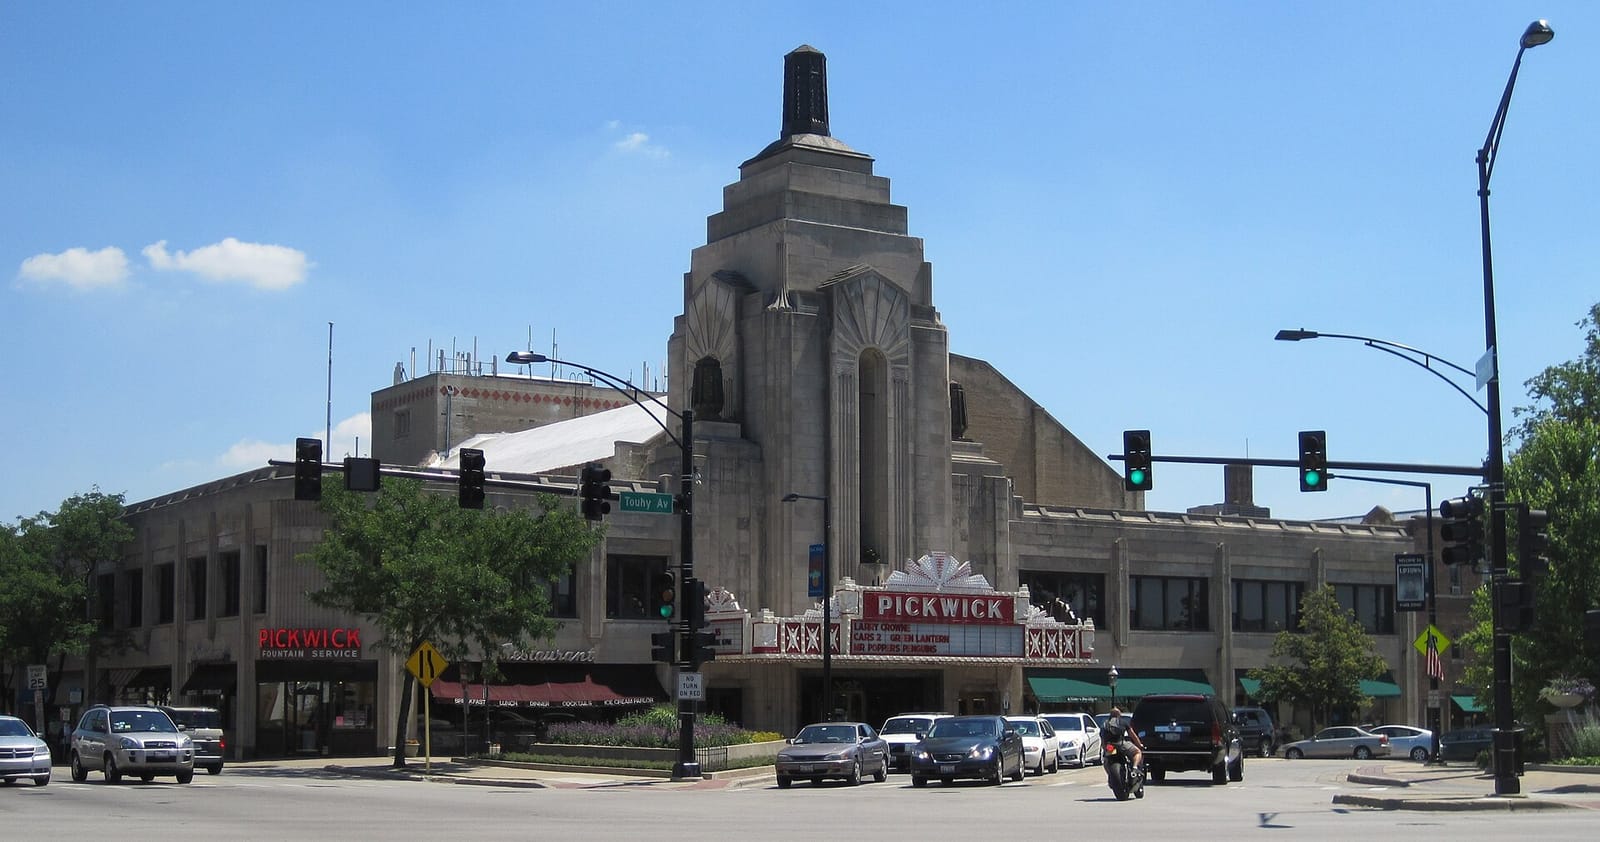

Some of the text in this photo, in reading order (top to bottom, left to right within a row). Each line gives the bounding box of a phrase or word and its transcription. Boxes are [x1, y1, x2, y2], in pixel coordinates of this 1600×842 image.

[624, 496, 669, 510] Touhy Av
[877, 595, 1004, 619] PICKWICK
[853, 622, 911, 633] LARRY CROWNE
[258, 627, 361, 649] PICKWICK
[853, 633, 950, 644] CARS 2 GREEN LANTERN
[262, 649, 358, 658] FOUNTAIN SERVICE
[853, 643, 937, 654] MR POPPERS PENGUINS
[30, 679, 45, 688] 25
